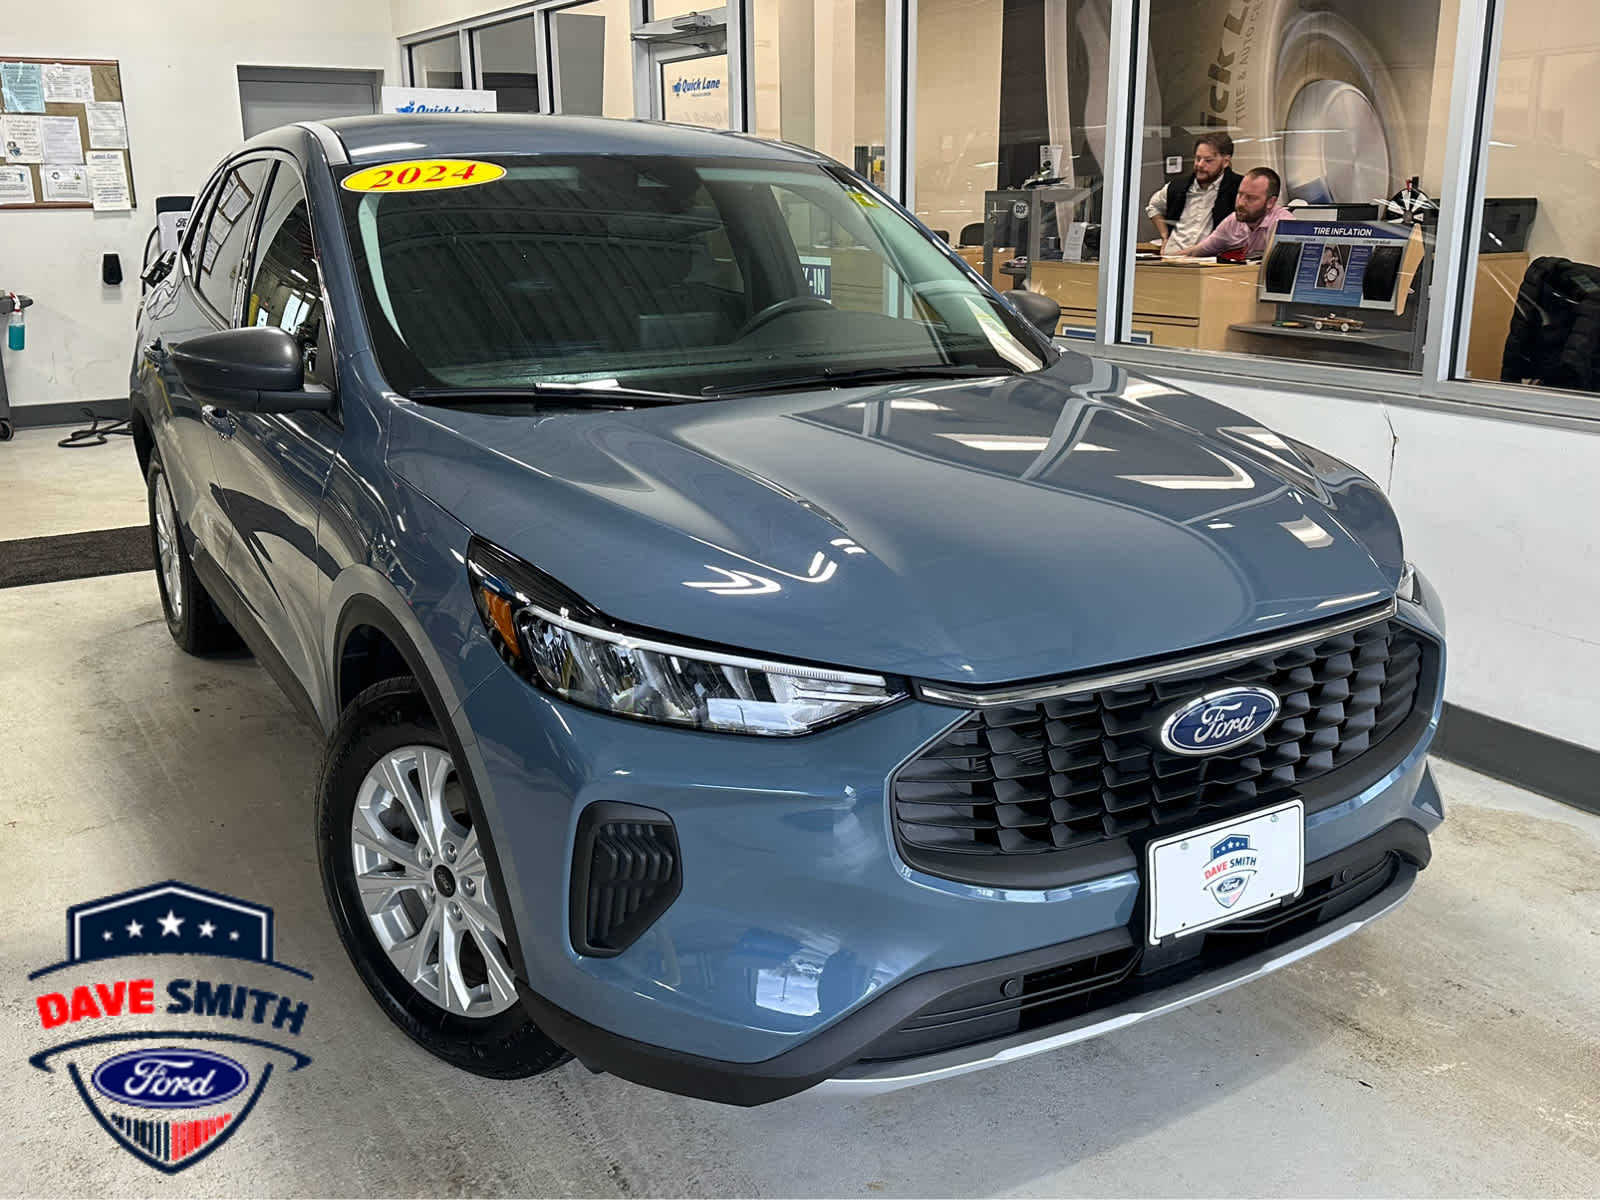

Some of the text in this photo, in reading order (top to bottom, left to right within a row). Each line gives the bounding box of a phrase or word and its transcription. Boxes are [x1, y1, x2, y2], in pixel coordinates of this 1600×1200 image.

[682, 77, 720, 93] Quick Lane
[368, 163, 476, 190] 2024
[1313, 227, 1373, 237] TIRE INFLATION
[1194, 701, 1257, 743] Ford
[1204, 856, 1257, 880] DAVE SMITH
